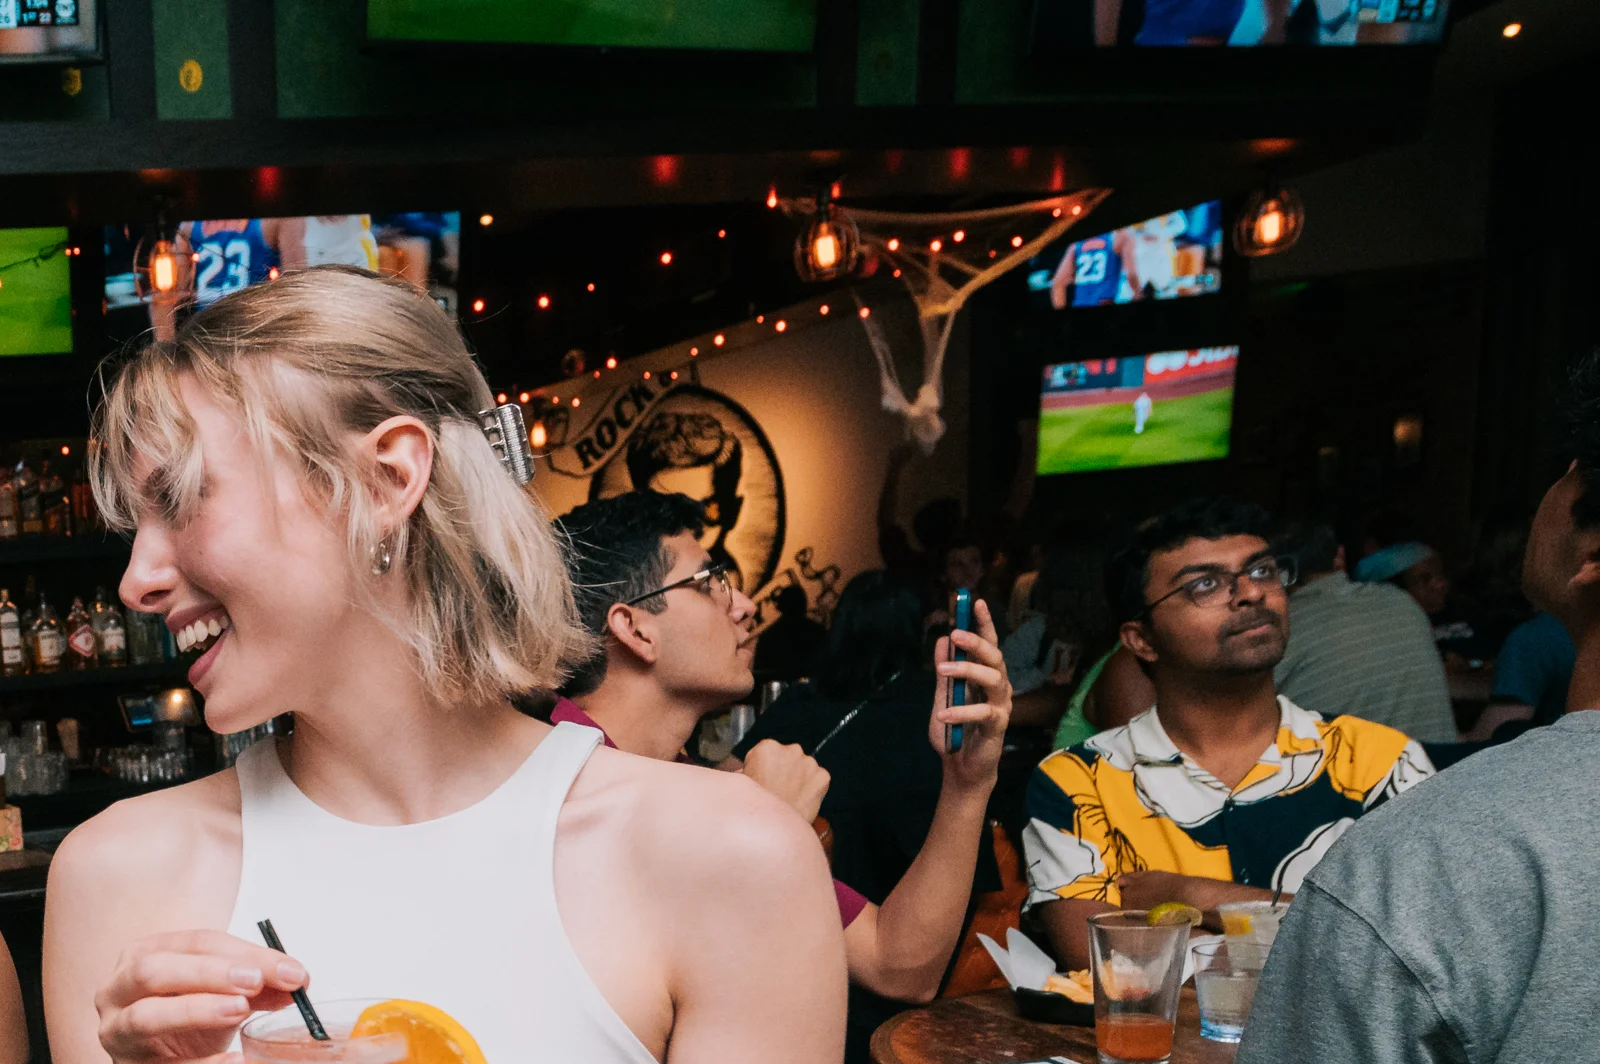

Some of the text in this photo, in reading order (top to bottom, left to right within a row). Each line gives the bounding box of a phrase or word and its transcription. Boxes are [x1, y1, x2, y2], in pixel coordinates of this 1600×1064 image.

[195, 238, 251, 303] 23
[1075, 251, 1107, 286] 23
[574, 380, 655, 470] ROCK
